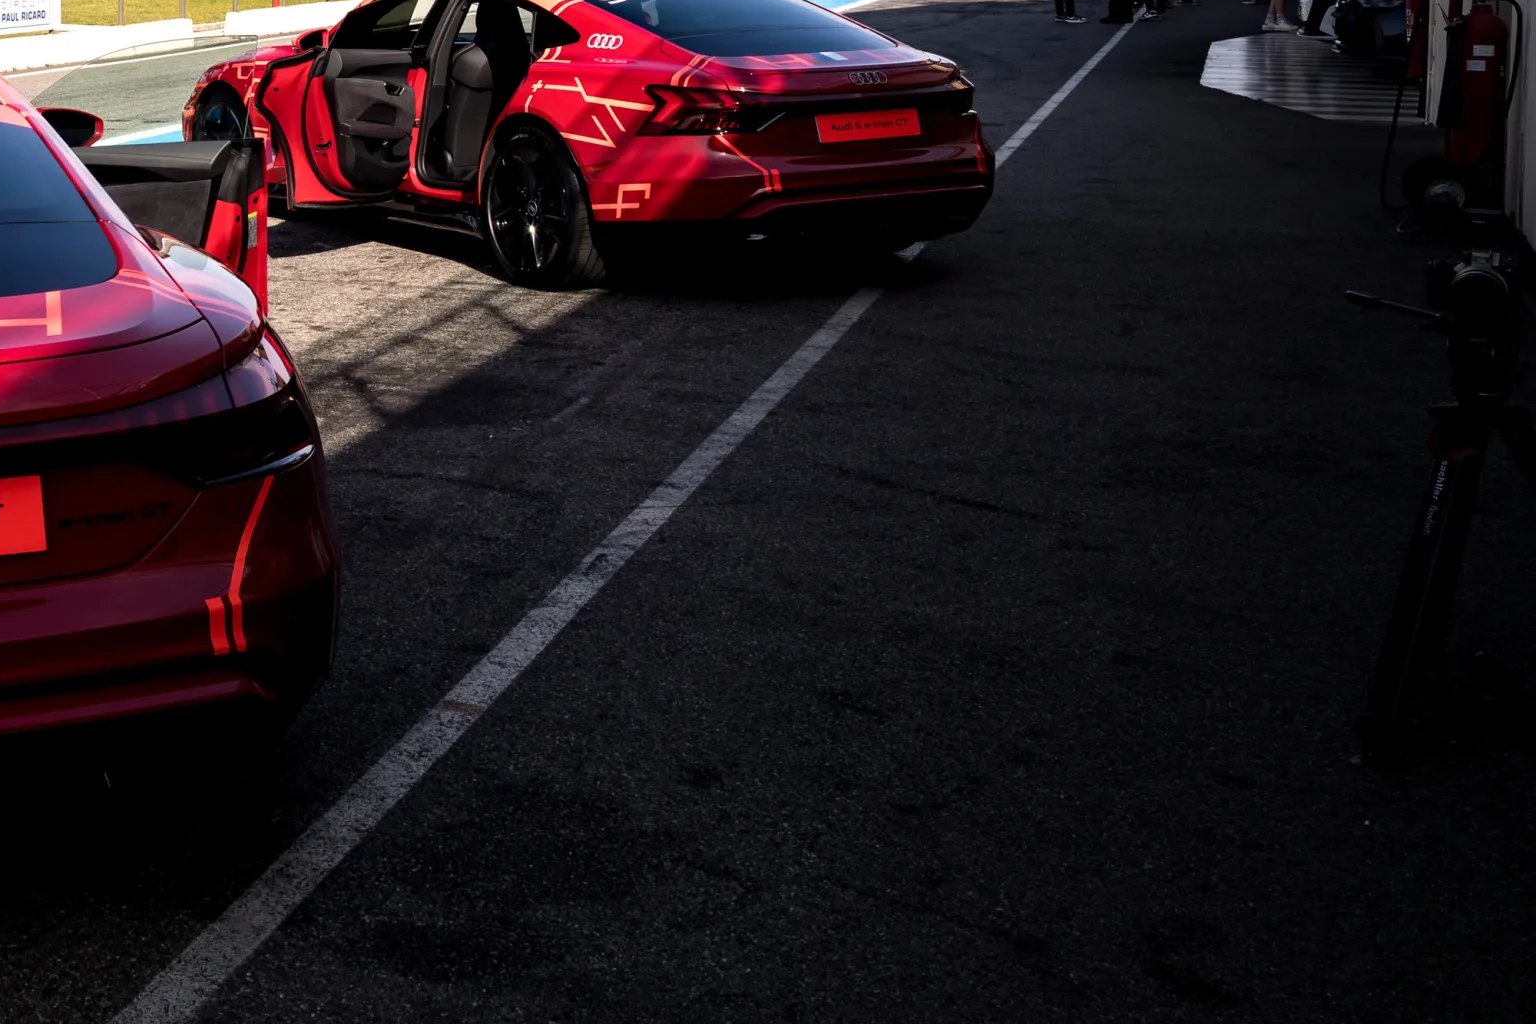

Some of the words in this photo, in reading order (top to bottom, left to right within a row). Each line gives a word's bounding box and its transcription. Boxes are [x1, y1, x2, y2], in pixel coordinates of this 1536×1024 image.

[1, 12, 19, 22] PAUL
[21, 10, 46, 21] RICARD
[831, 122, 853, 132] Audi
[855, 121, 862, 130] S
[864, 119, 893, 130] e-tron
[895, 118, 908, 127] GT
